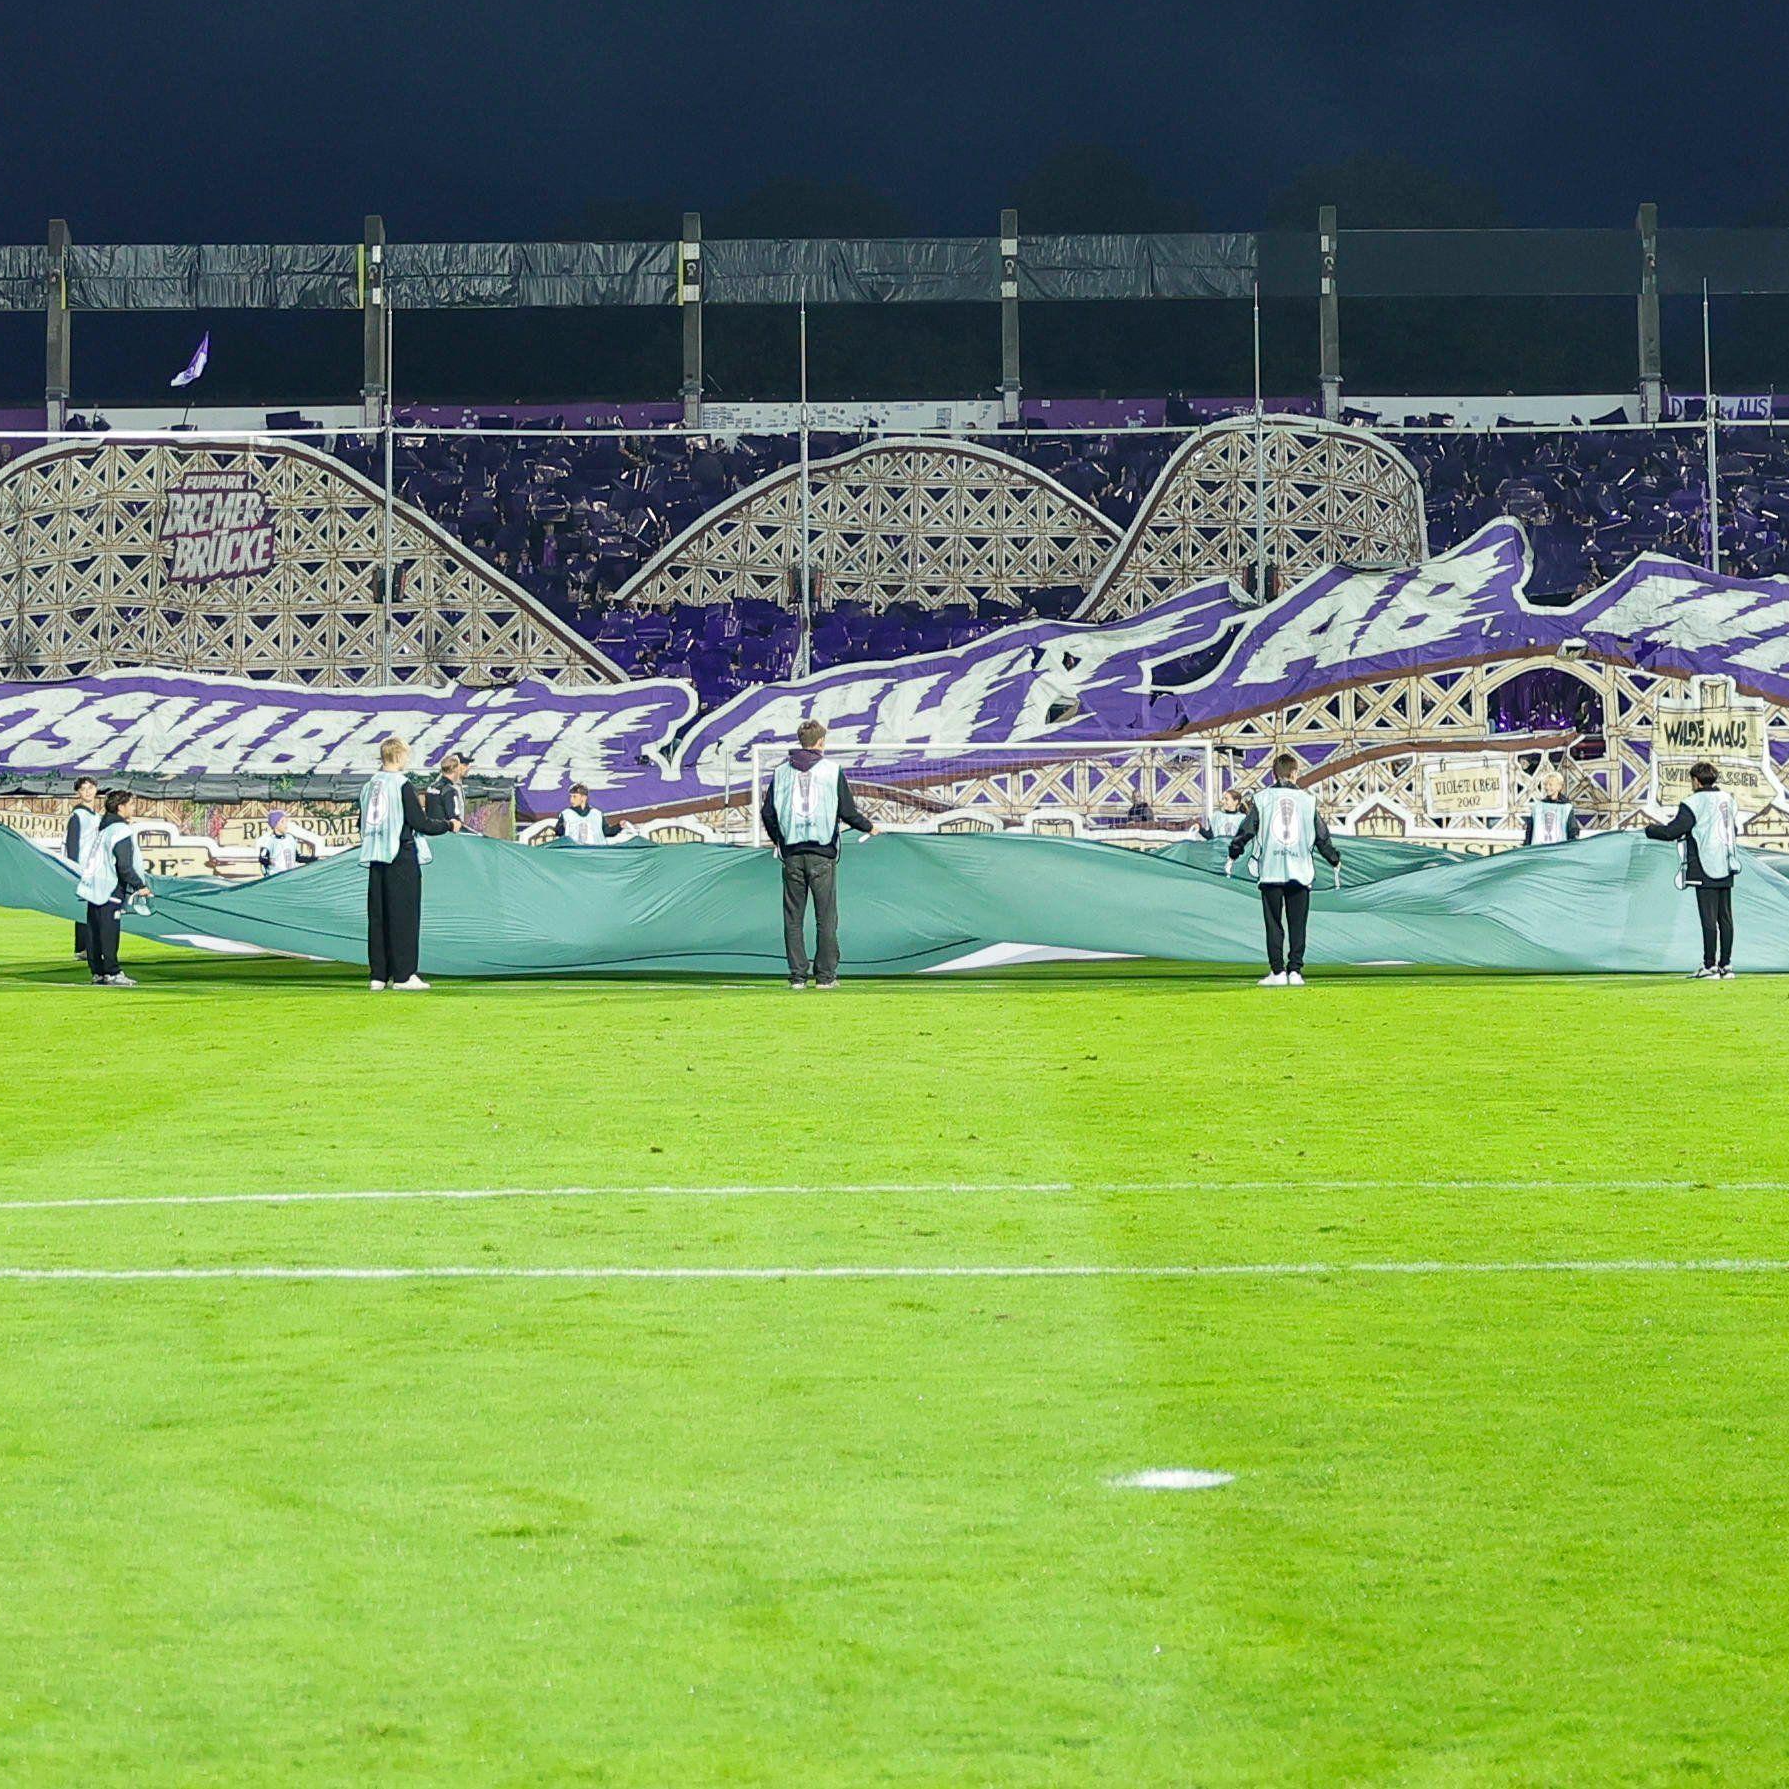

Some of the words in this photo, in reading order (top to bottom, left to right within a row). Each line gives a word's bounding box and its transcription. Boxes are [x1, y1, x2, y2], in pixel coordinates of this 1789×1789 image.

[183, 474, 248, 490] FUNPARK
[171, 527, 273, 579] BRÜCKE
[1232, 538, 1512, 688] AB
[1664, 720, 1705, 748] WILDE
[1708, 720, 1748, 750] MAUS
[1435, 779, 1472, 796] VIOLET
[1457, 796, 1481, 808] 2002
